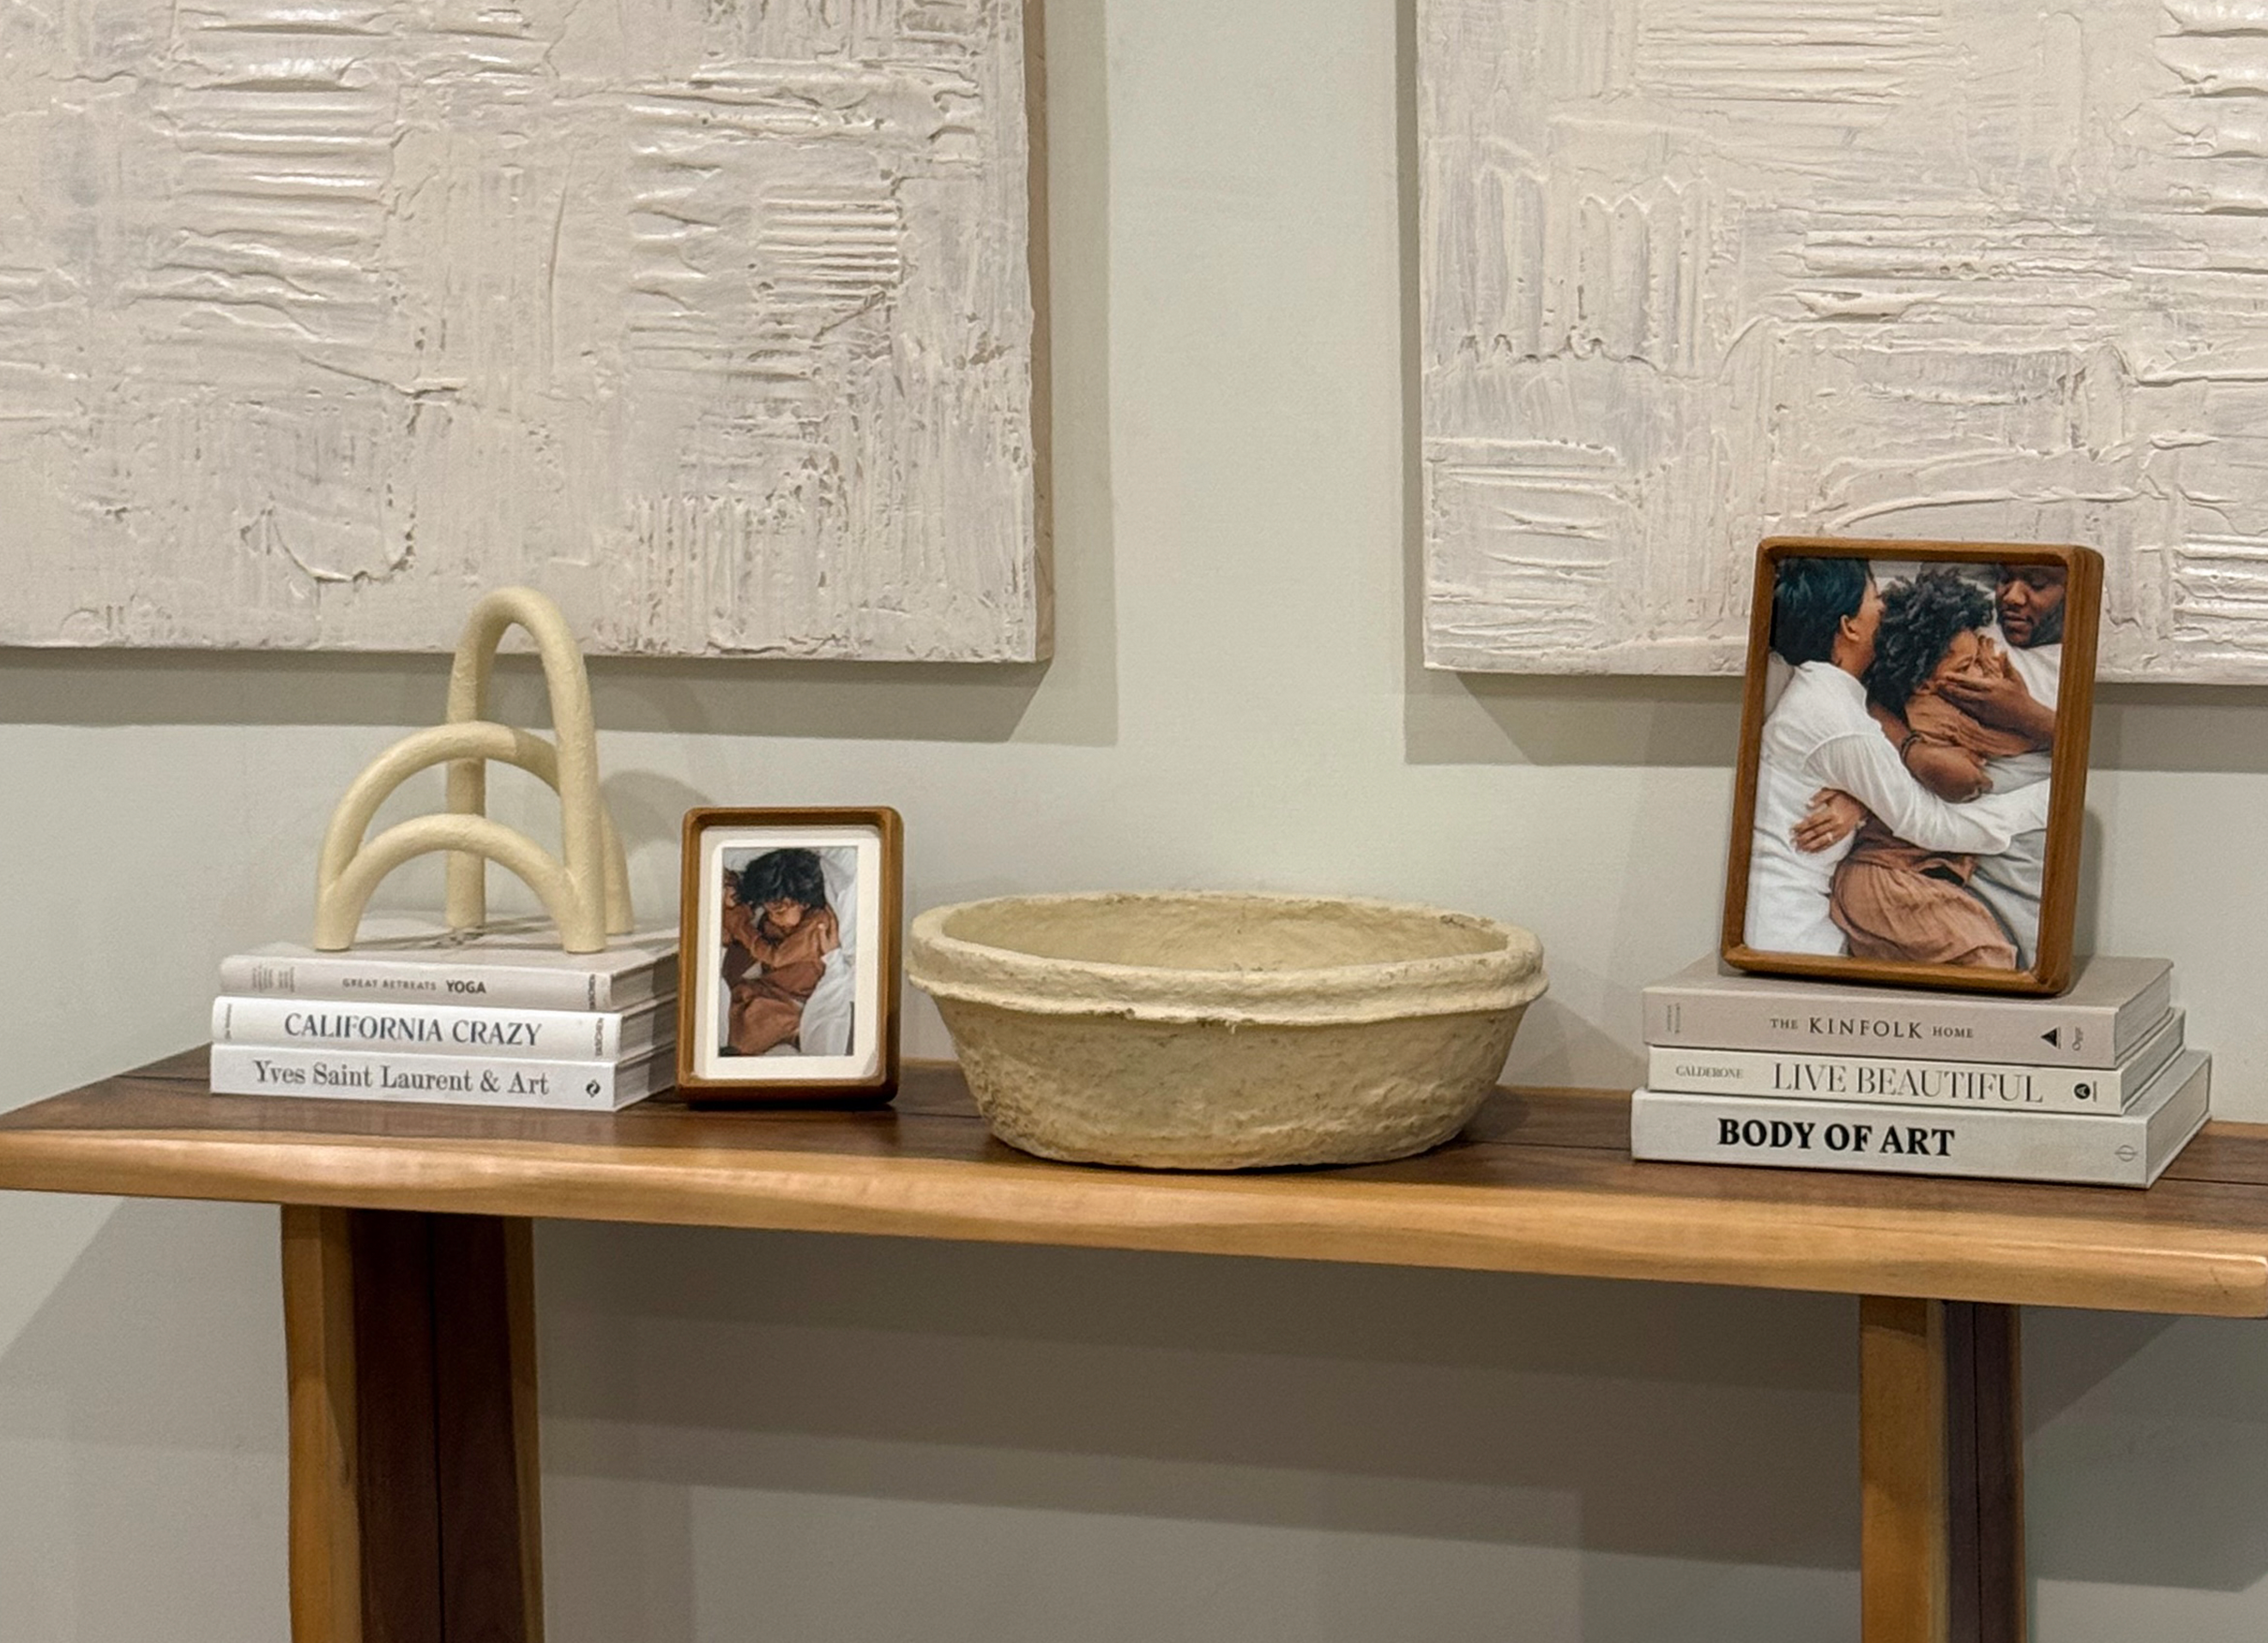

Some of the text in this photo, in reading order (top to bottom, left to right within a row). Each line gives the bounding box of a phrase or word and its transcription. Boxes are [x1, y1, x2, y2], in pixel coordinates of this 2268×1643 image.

[445, 980, 486, 994] YOGA
[284, 1012, 542, 1047] CALIFORNIA CRAZY
[1770, 1017, 1974, 1040] THE KINFOLK HOME
[253, 1060, 550, 1096] Yves Saint Laurent & Art
[1772, 1062, 1847, 1093] LIVE
[1856, 1066, 2043, 1103] BEAUTIFUL
[1717, 1117, 1956, 1157] BODY OF ART
